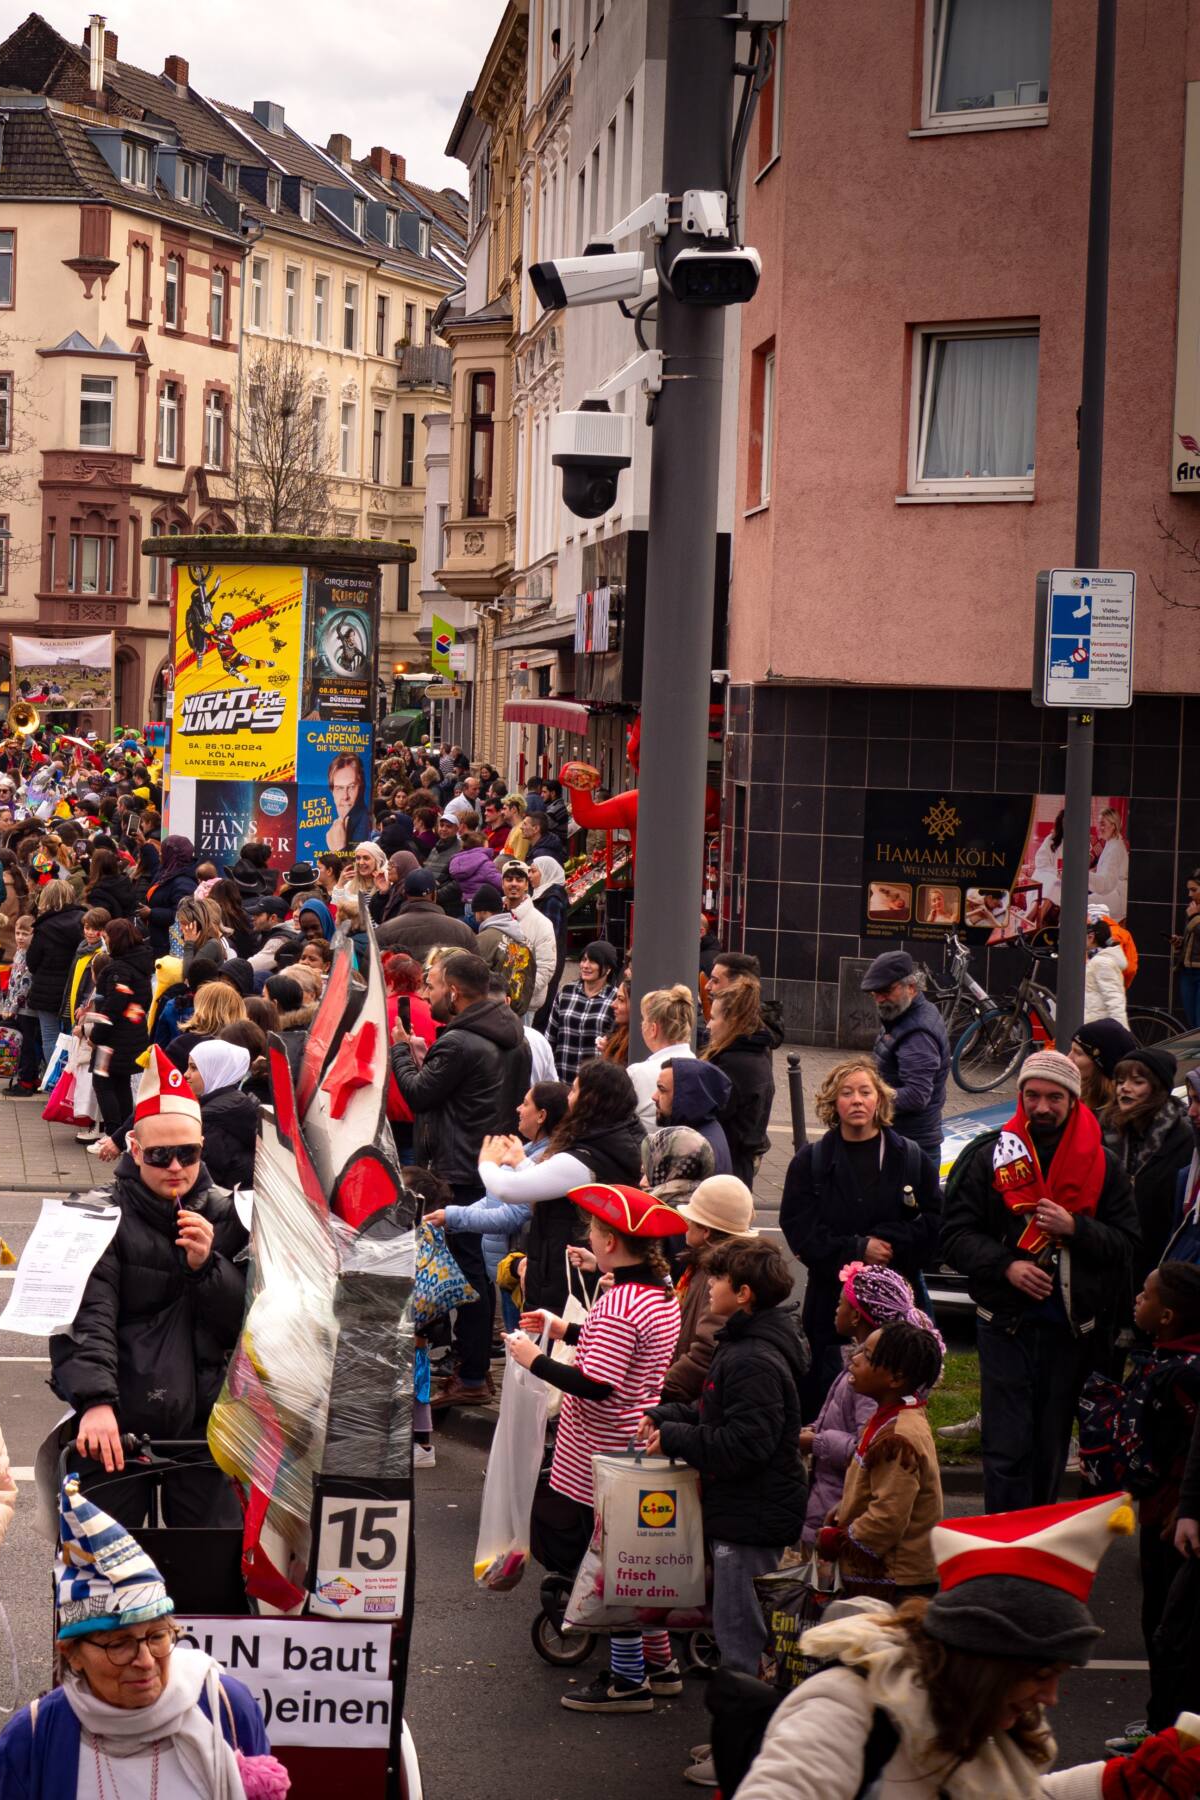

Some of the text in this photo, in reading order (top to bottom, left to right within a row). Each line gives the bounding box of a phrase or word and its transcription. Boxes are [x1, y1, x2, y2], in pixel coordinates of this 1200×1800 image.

[324, 577, 349, 588] CIRQUE
[181, 688, 259, 714] NIGHT
[258, 690, 280, 699] OF
[254, 698, 287, 707] THE
[176, 706, 286, 733] JUMPS
[328, 724, 361, 733] HOWARD
[306, 732, 370, 745] CARPENDALE
[205, 743, 262, 751] 26.10.2024
[316, 744, 327, 752] DIE
[208, 750, 235, 759] KÖLN
[184, 759, 267, 768] LANXESS ARENA
[302, 797, 327, 810] LET'S
[307, 805, 332, 819] DO IT
[201, 818, 258, 835] HANS
[298, 815, 332, 829] AGAIN!
[876, 843, 1006, 867] HAMAM KÖLN
[902, 864, 950, 877] WELLNESS
[960, 869, 977, 878] SPA
[328, 1506, 398, 1570] 15
[618, 1551, 694, 1565] Ganz schön
[616, 1567, 656, 1581] frisch
[615, 1583, 680, 1598] hier drin.
[177, 1625, 378, 1673] ÖLN baut
